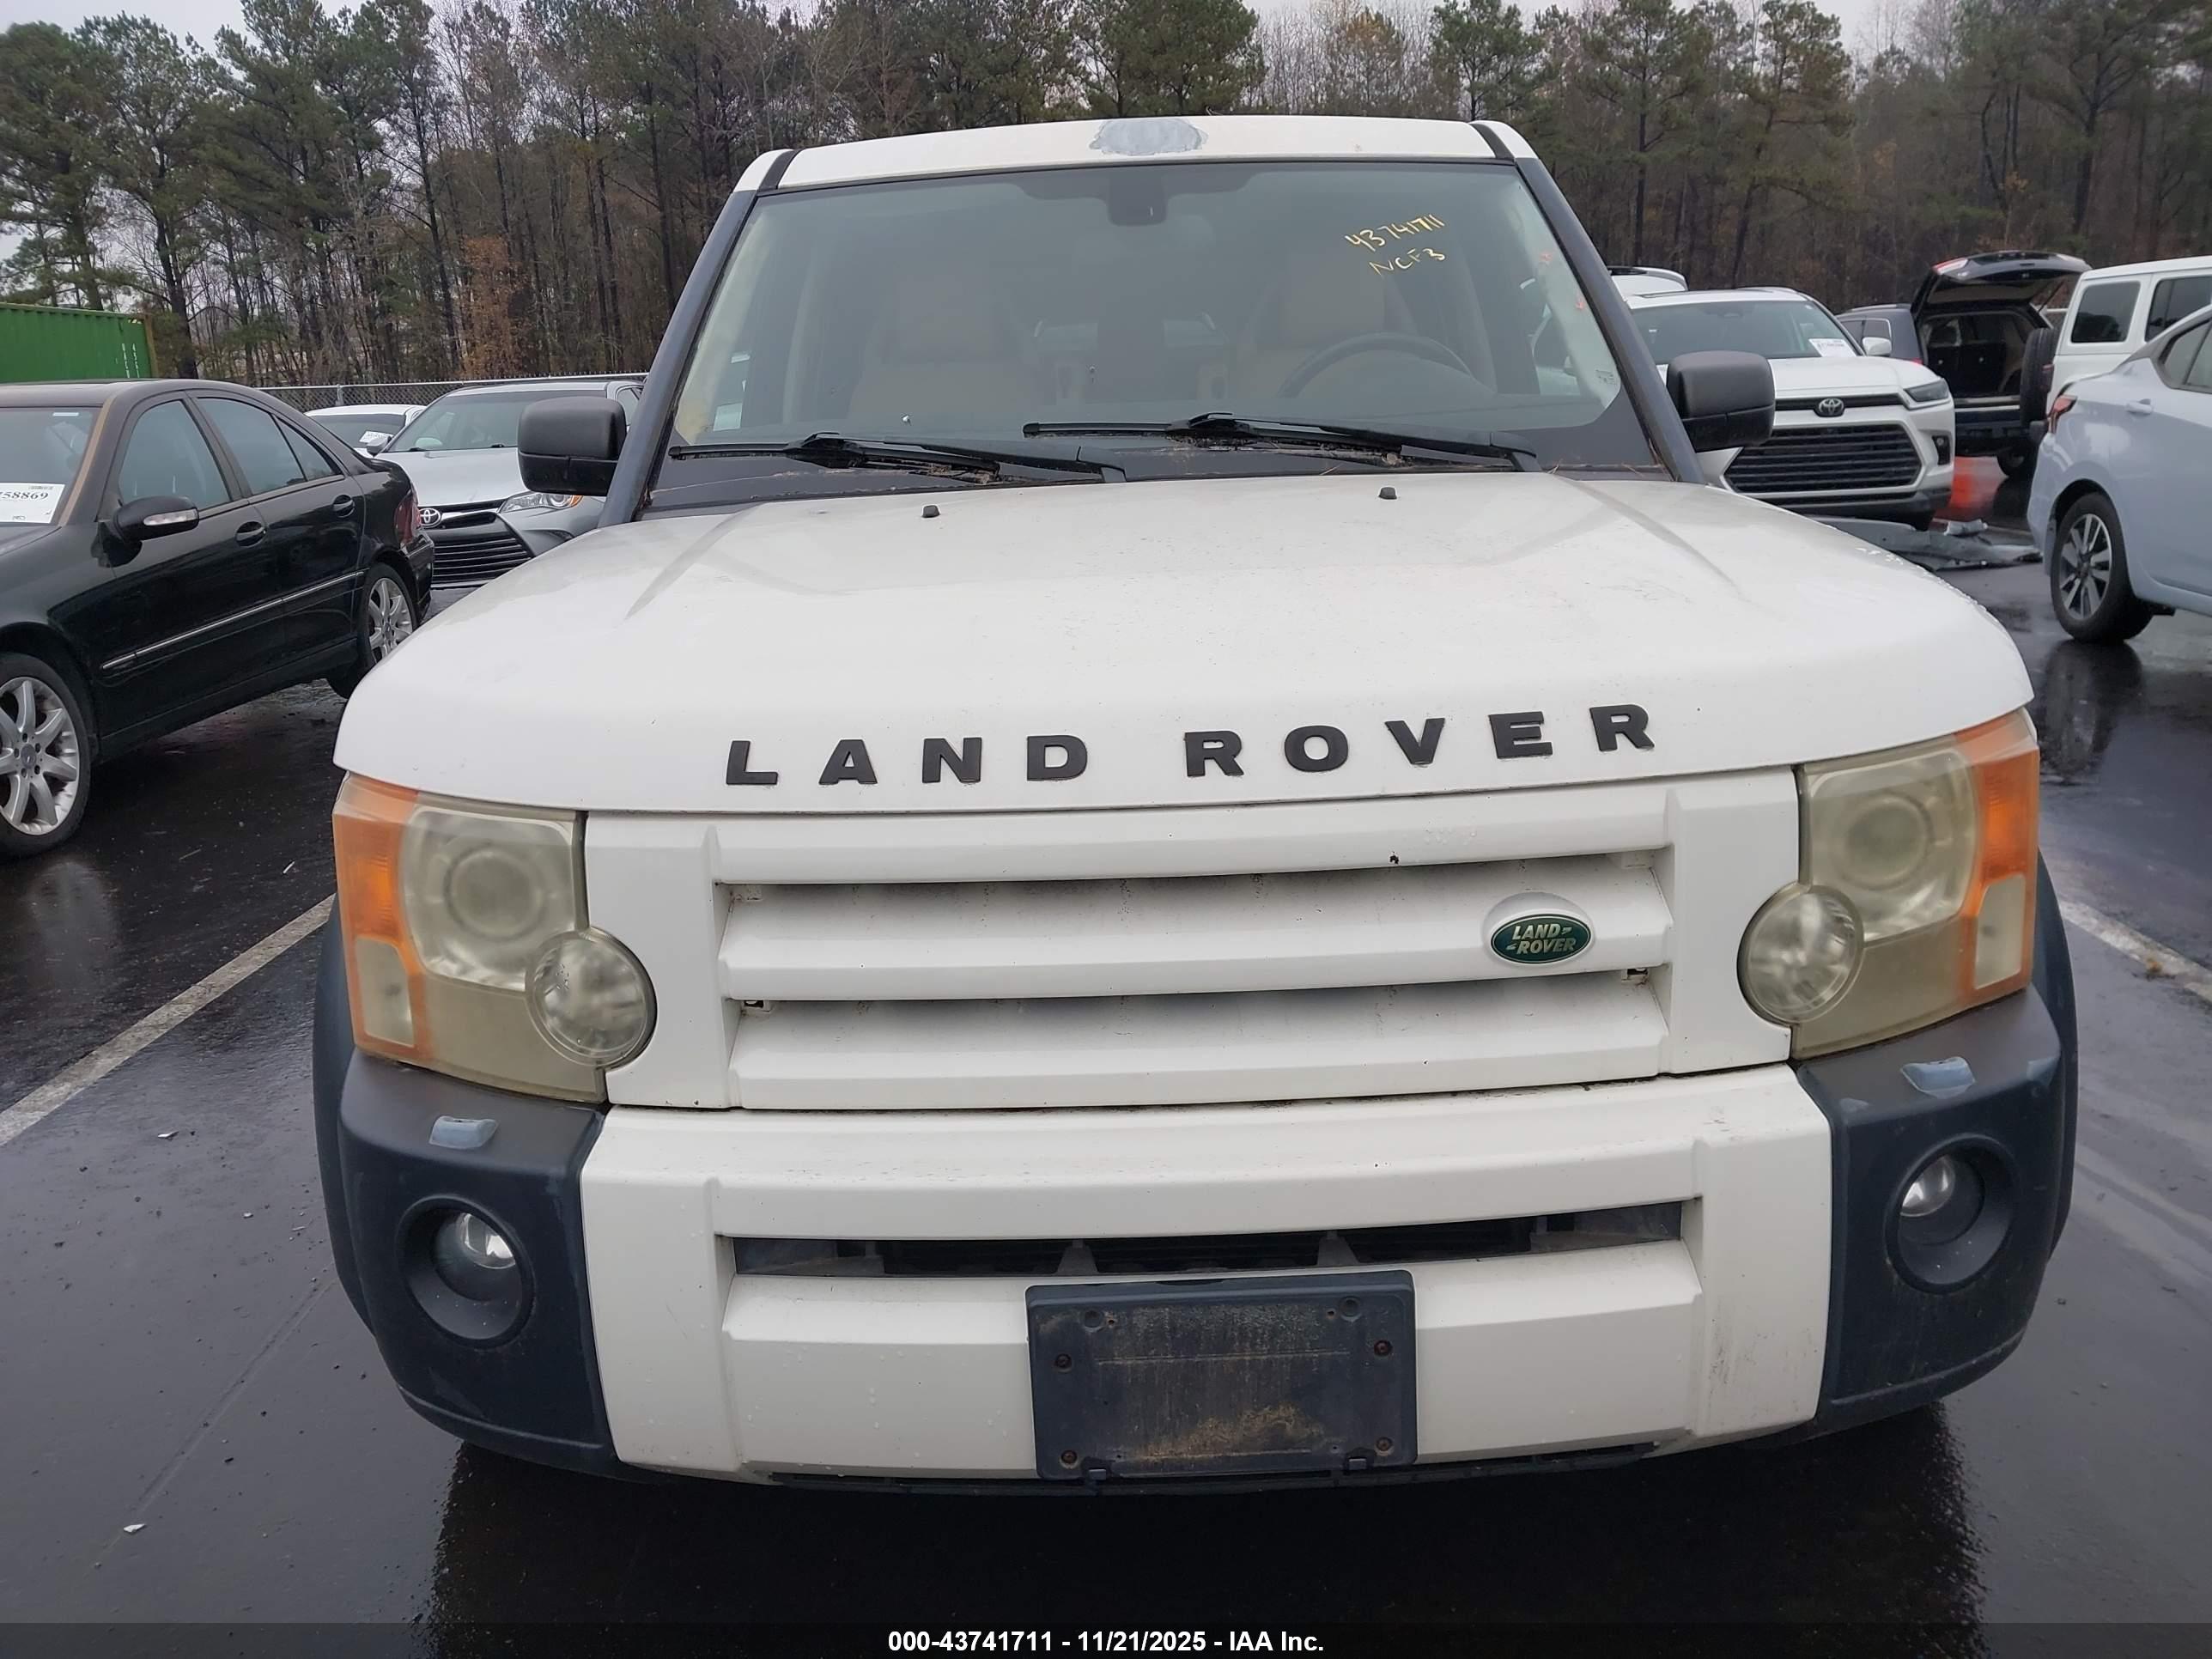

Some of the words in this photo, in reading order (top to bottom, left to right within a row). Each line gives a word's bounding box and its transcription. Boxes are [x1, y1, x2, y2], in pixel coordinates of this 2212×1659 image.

[1344, 214, 1445, 252] 43741711
[1368, 247, 1446, 276] NCF3
[726, 733, 1089, 786] LAND
[1182, 703, 1656, 778] ROVER
[1511, 923, 1561, 941] LAND
[1516, 937, 1577, 956] ROVER
